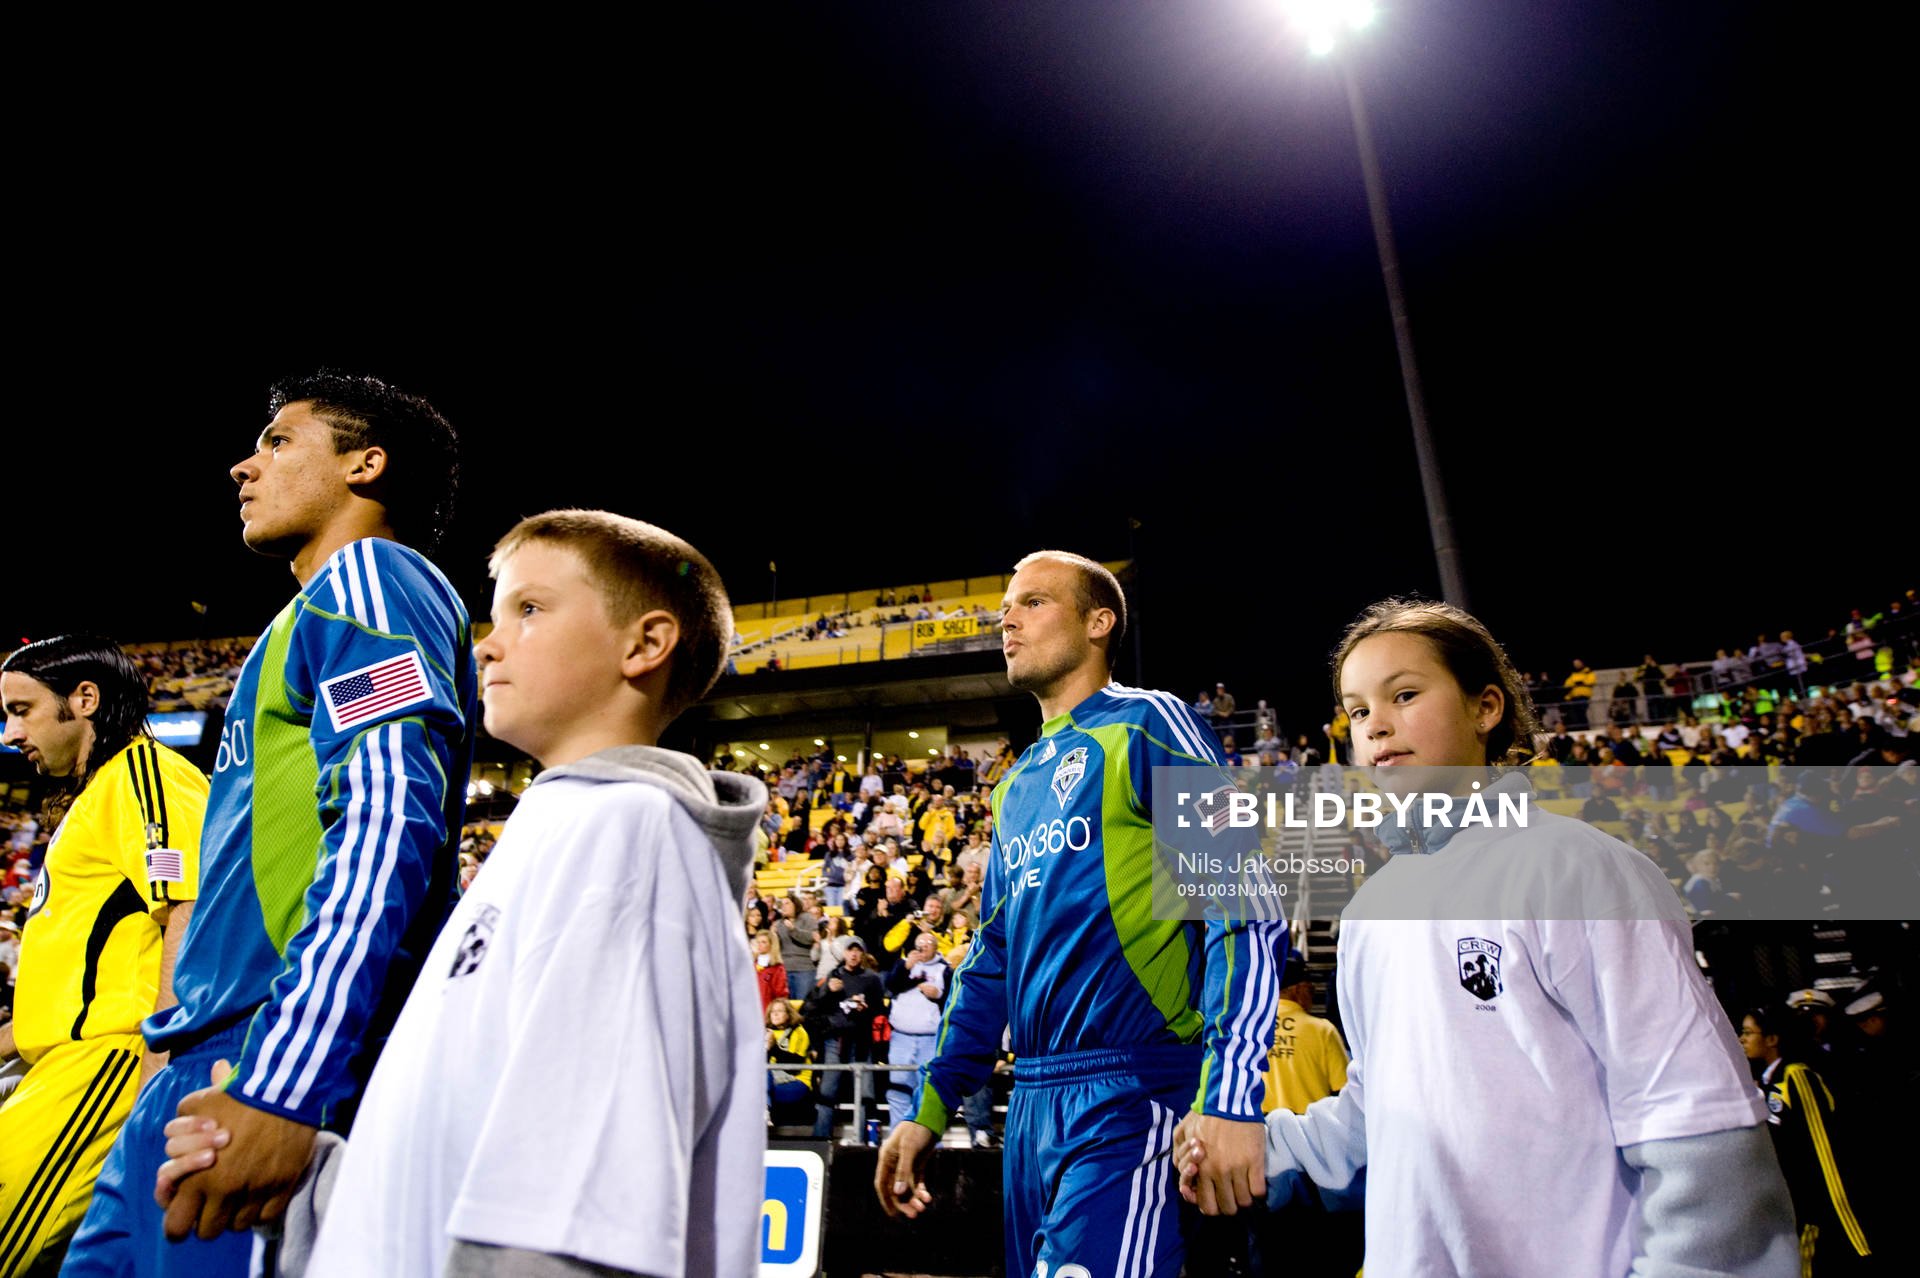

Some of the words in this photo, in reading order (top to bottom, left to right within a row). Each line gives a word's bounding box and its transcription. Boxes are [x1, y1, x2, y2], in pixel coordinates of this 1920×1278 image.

[916, 623, 935, 638] BOB
[943, 618, 974, 636] SAGET
[1460, 940, 1498, 954] CREW
[1475, 1004, 1497, 1012] 2008
